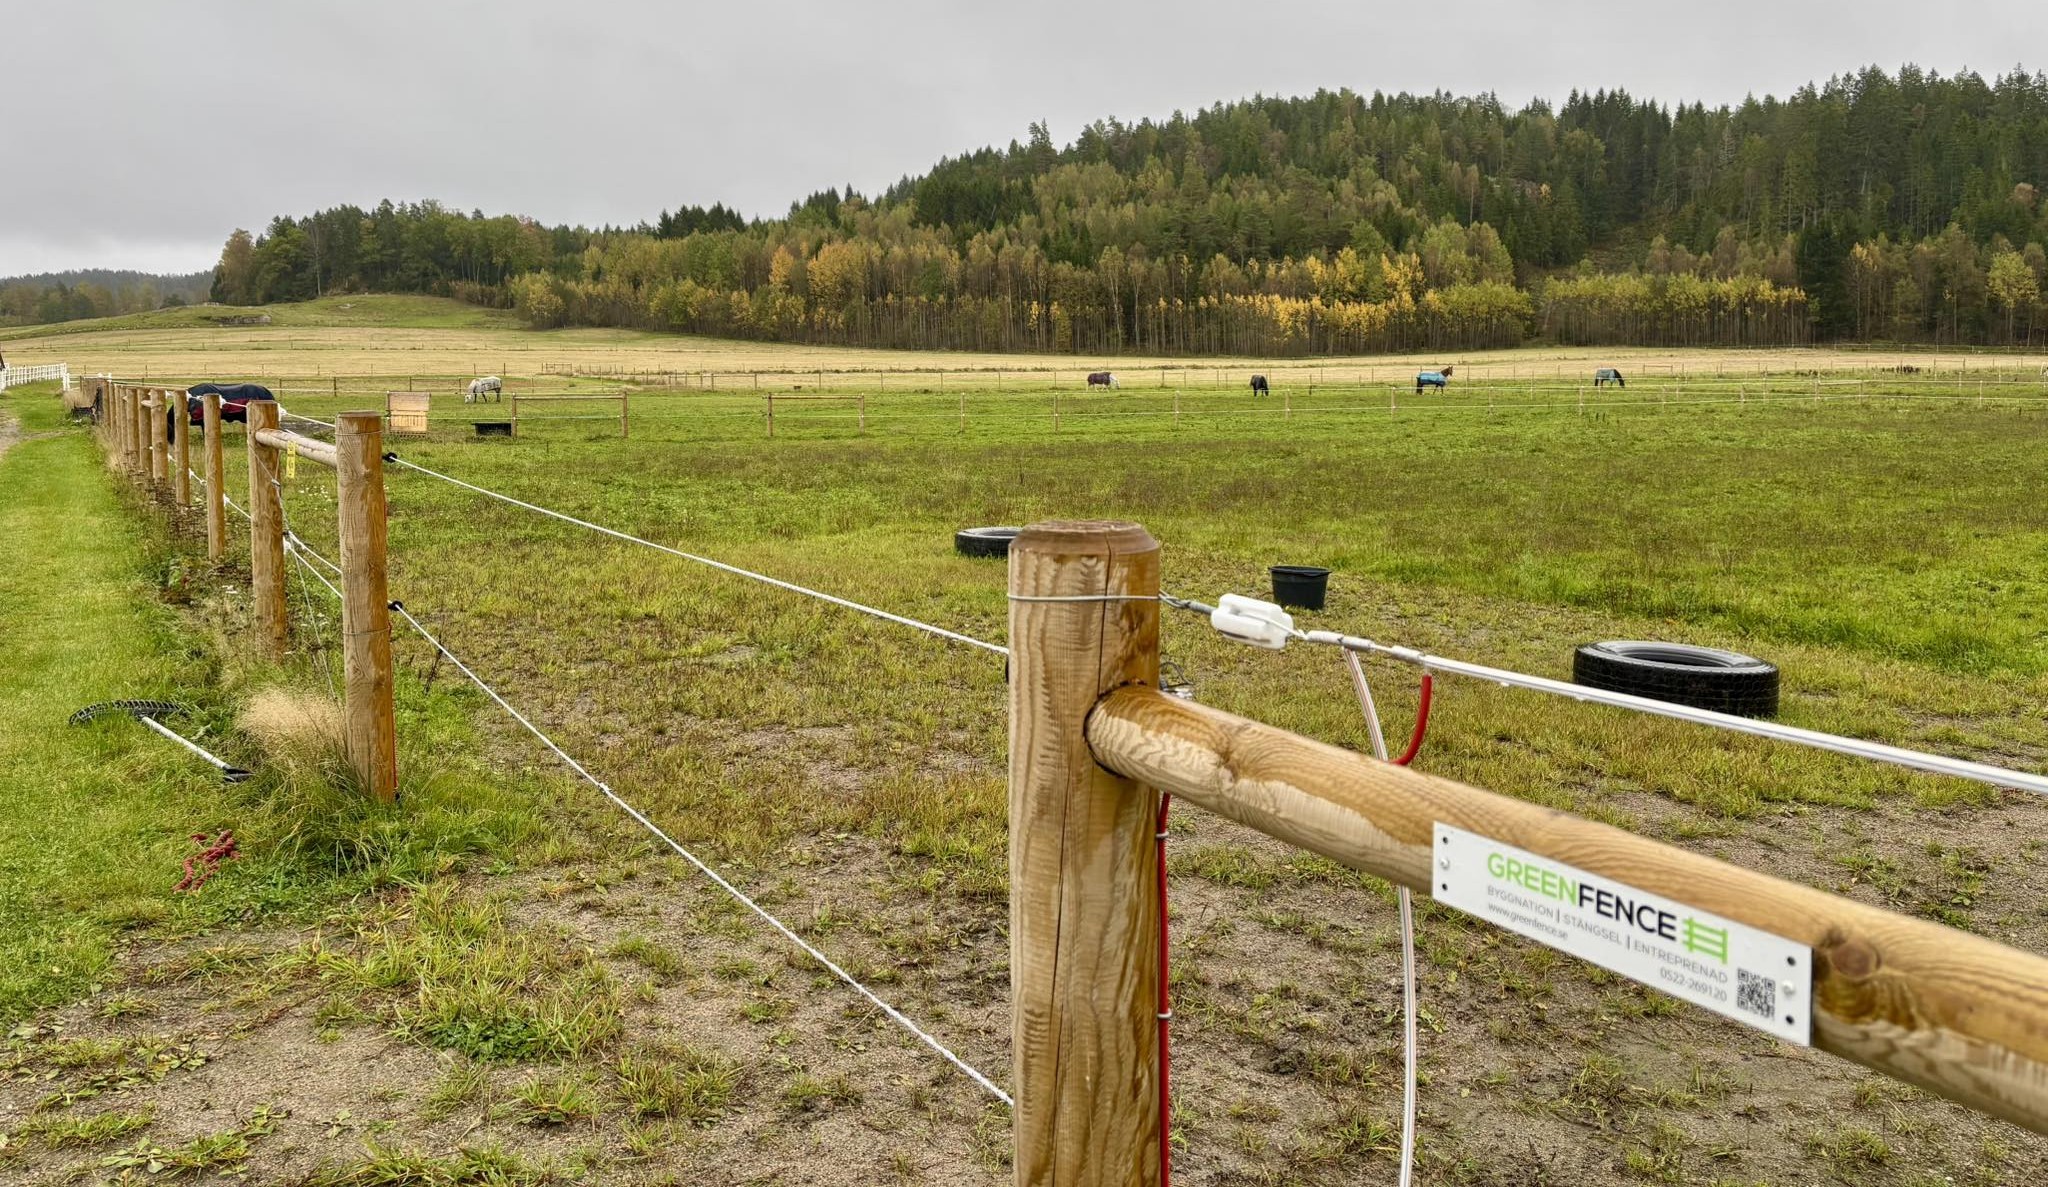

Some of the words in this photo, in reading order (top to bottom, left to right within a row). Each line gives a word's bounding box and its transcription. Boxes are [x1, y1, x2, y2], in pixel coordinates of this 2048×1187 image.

[1487, 852, 1677, 942] GREENFENCE
[1488, 903, 1569, 941] www.greenfence.se
[1487, 885, 1554, 919] BYGGNATION
[1634, 942, 1728, 984] ENTREPRENAD
[1660, 967, 1728, 1002] 0522-269120
